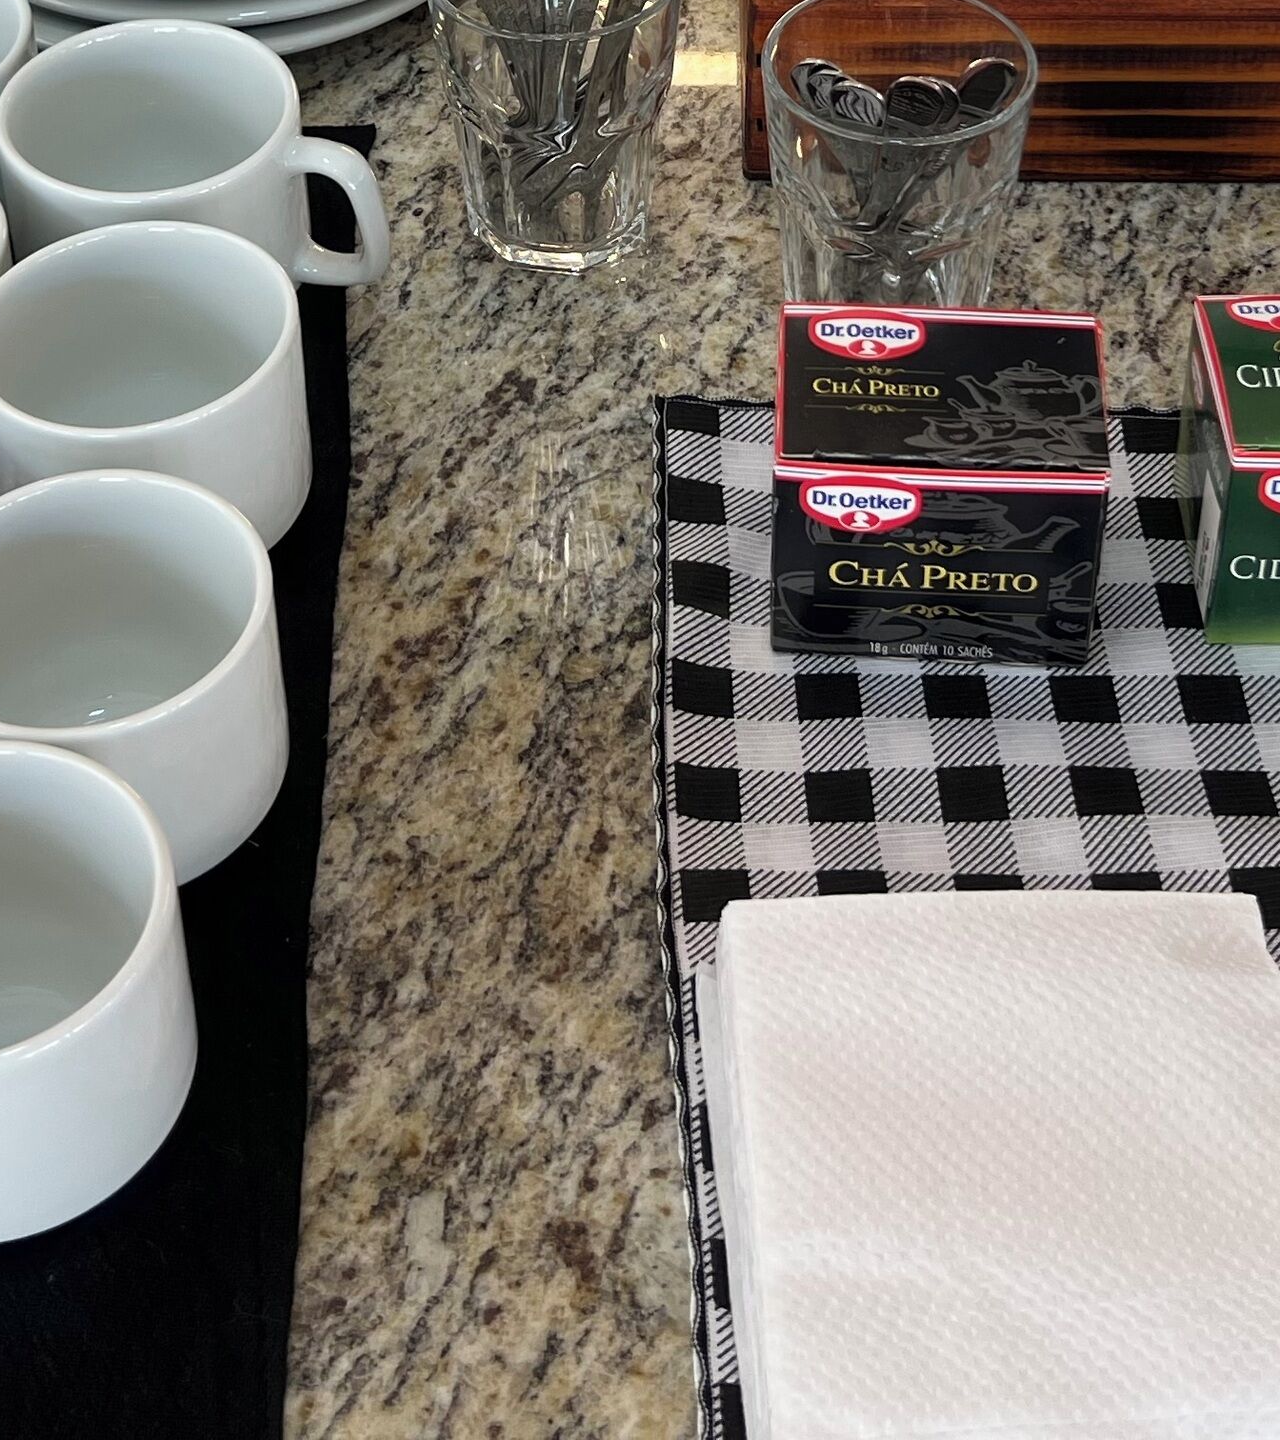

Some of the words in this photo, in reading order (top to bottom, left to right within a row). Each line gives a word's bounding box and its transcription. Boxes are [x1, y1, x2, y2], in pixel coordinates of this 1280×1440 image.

[812, 377, 863, 395] CHÁ
[868, 379, 940, 398] PRETO
[828, 560, 912, 589] CHÁ
[919, 564, 1039, 594] PRETO
[870, 641, 888, 656] 18g
[900, 641, 938, 656] CONTÉM
[942, 644, 955, 656] 10
[957, 644, 994, 658] SACHÊS
